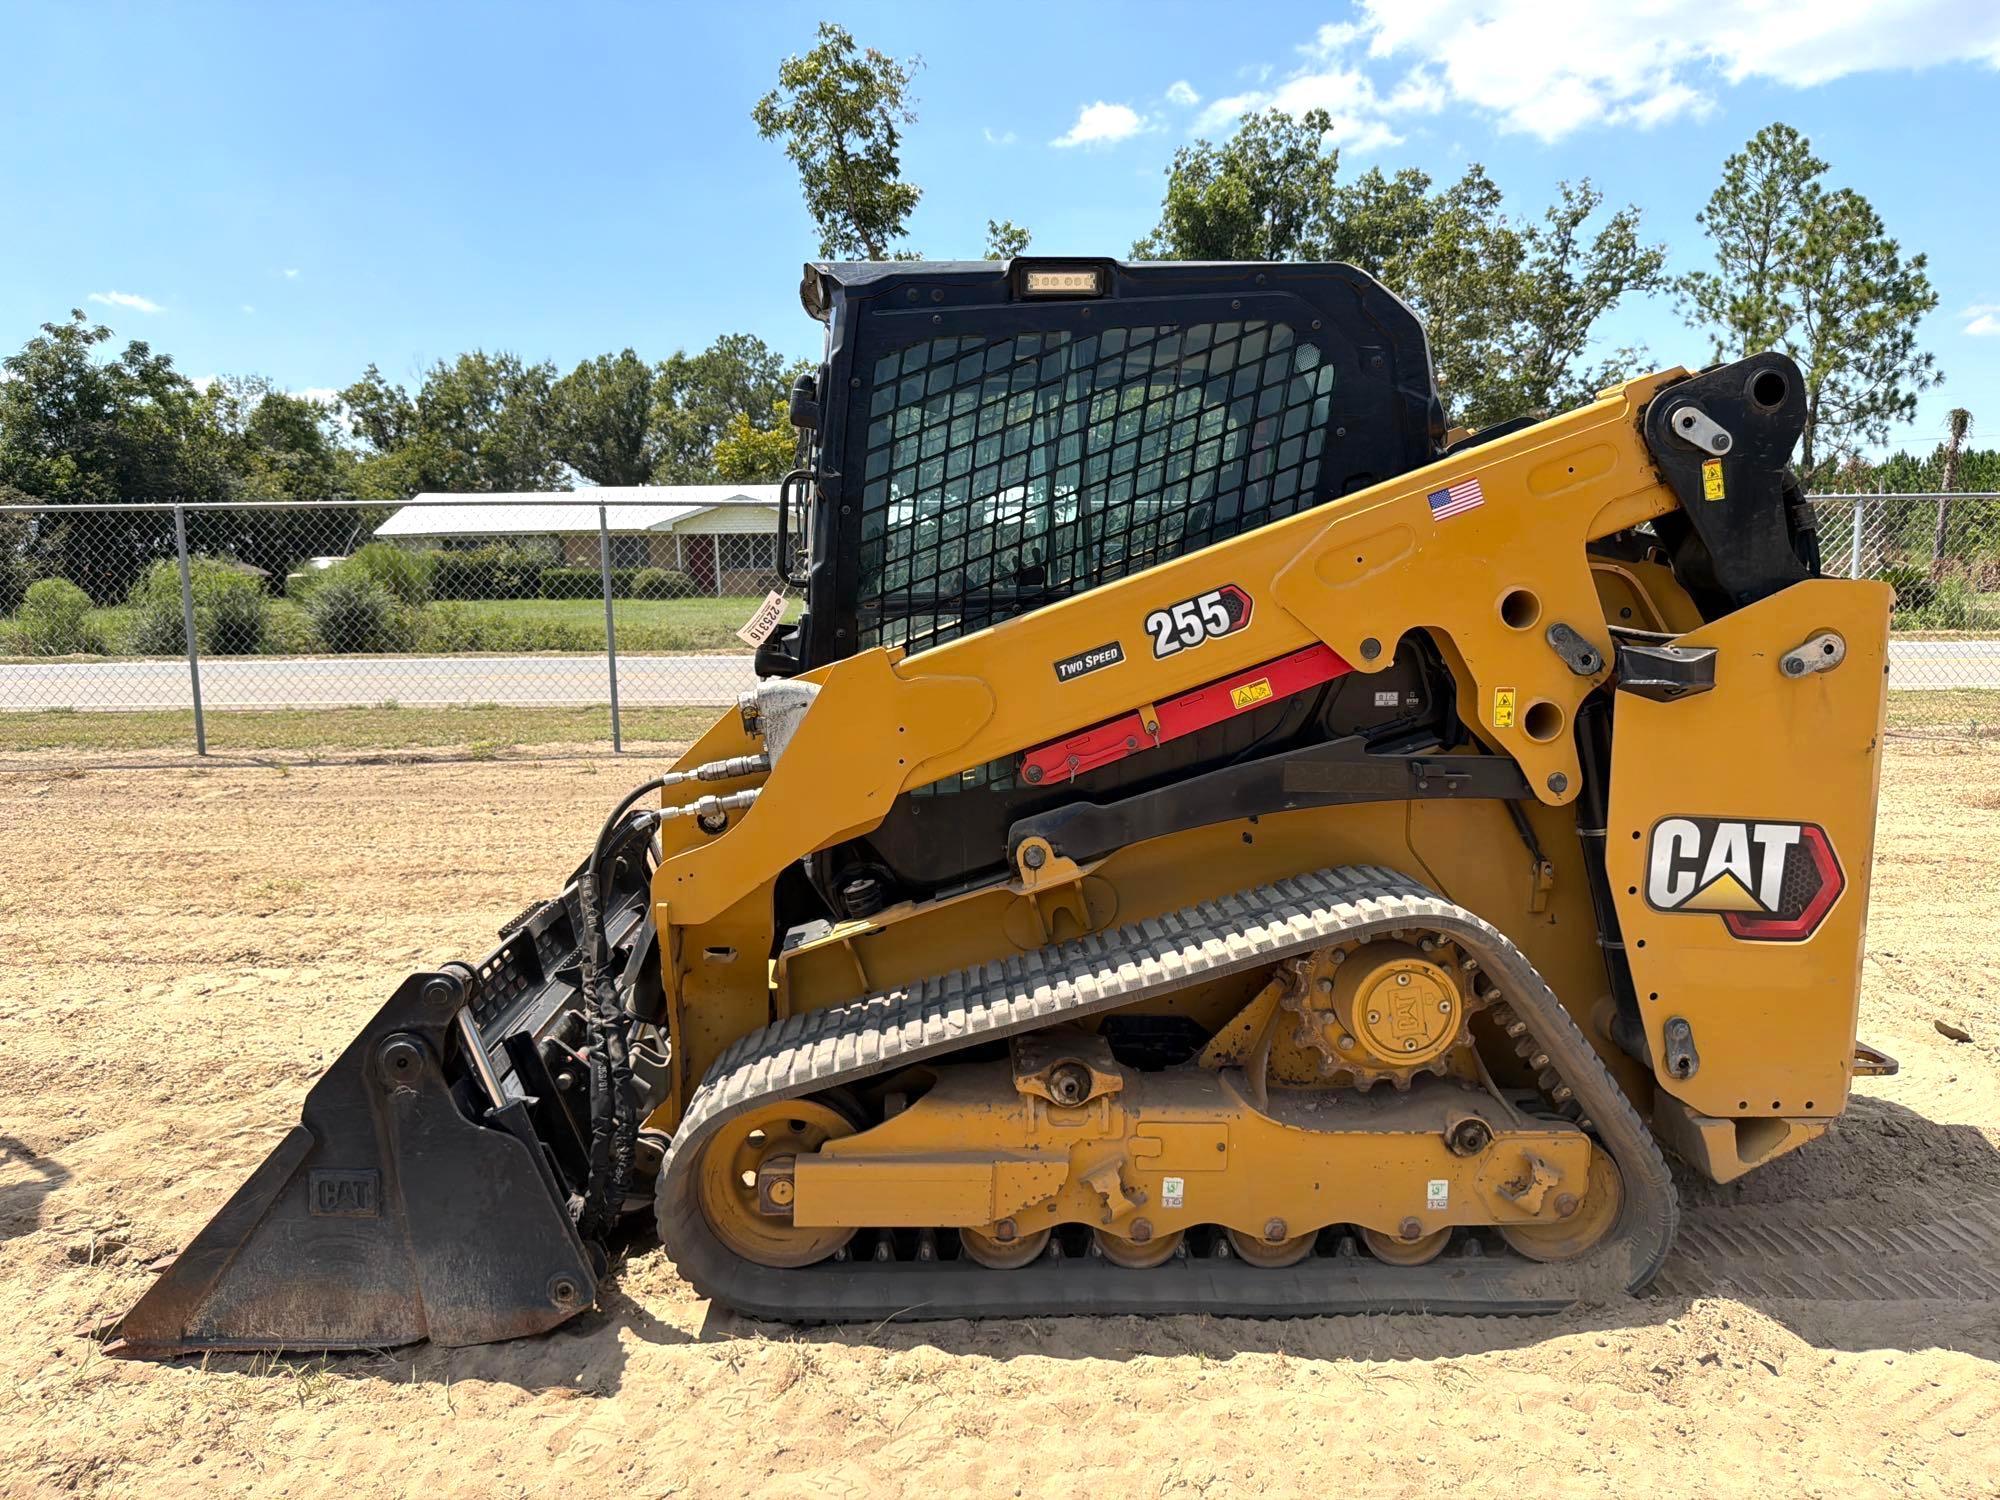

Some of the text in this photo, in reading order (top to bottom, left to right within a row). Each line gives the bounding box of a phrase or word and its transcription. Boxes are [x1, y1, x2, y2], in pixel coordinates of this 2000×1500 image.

[750, 606, 780, 641] 225316
[1147, 591, 1230, 656] 255
[1648, 818, 1801, 912] CAT
[1394, 992, 1419, 1031] CAT
[319, 1180, 369, 1209] CAT
